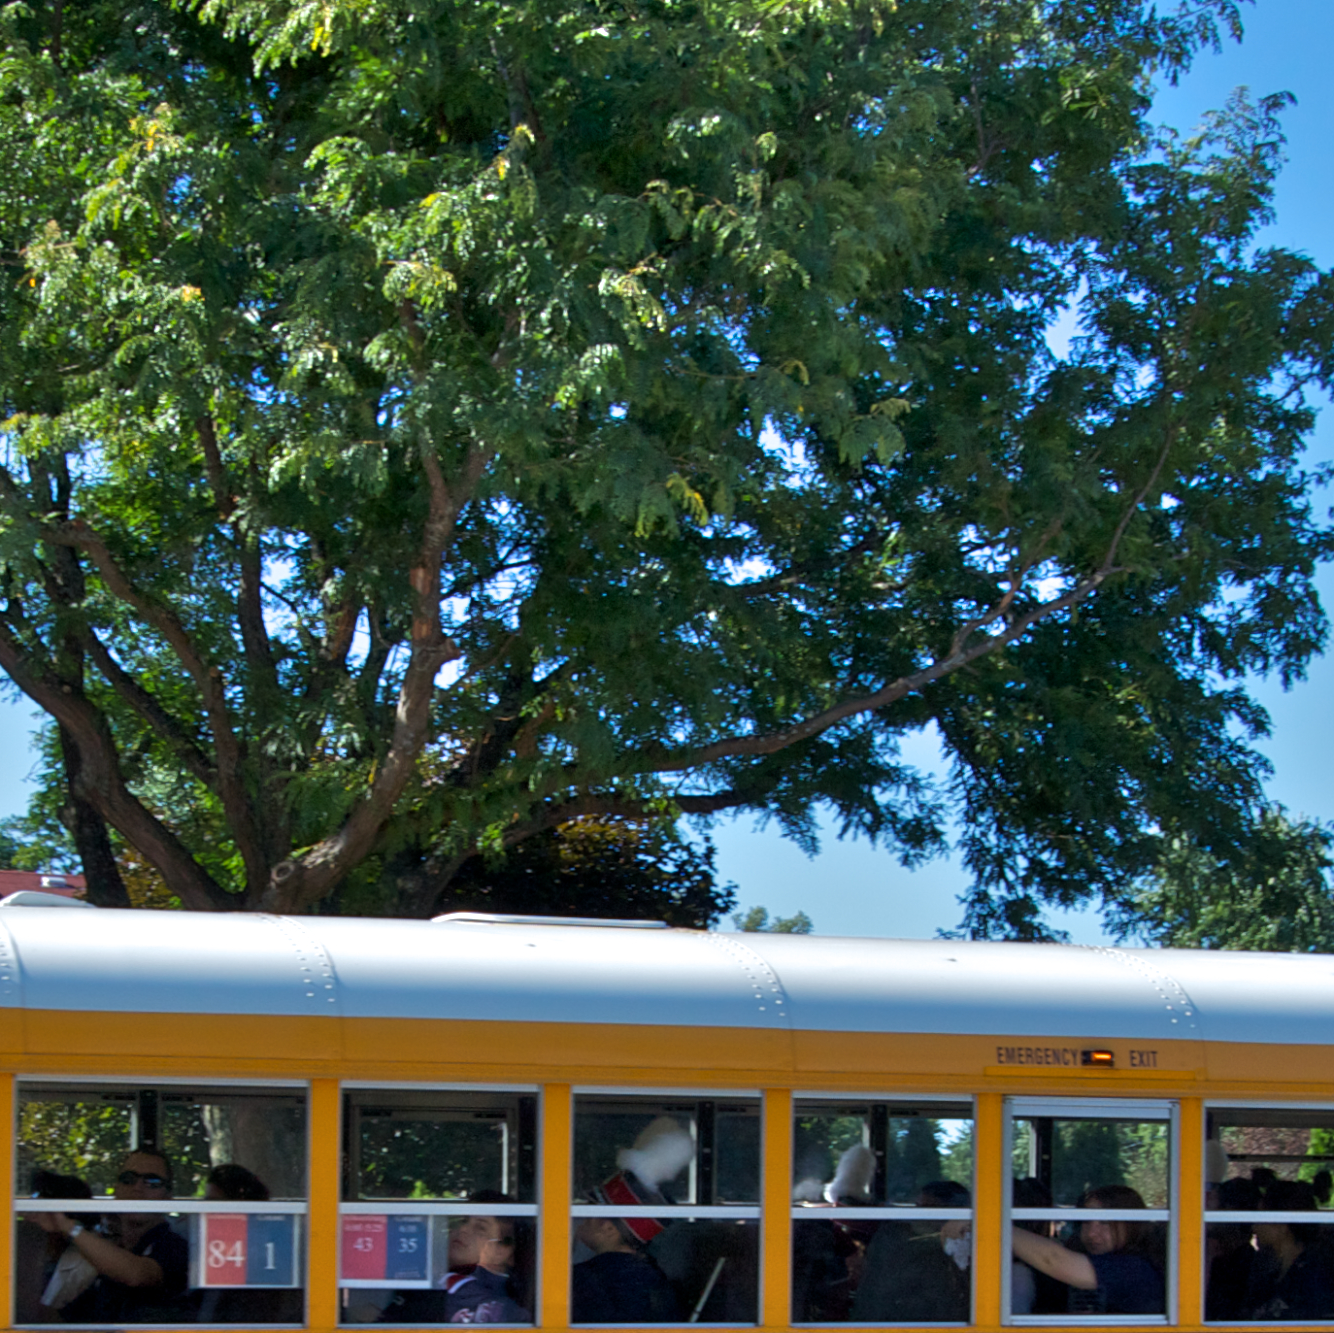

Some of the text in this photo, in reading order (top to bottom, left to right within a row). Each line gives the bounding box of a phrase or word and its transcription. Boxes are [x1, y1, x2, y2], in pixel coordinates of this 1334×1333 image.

[996, 1046, 1158, 1068] EMERGENCY EXIT
[207, 1239, 245, 1269] 84
[264, 1241, 276, 1270] 1
[353, 1237, 374, 1252] 43
[398, 1237, 418, 1253] 35
